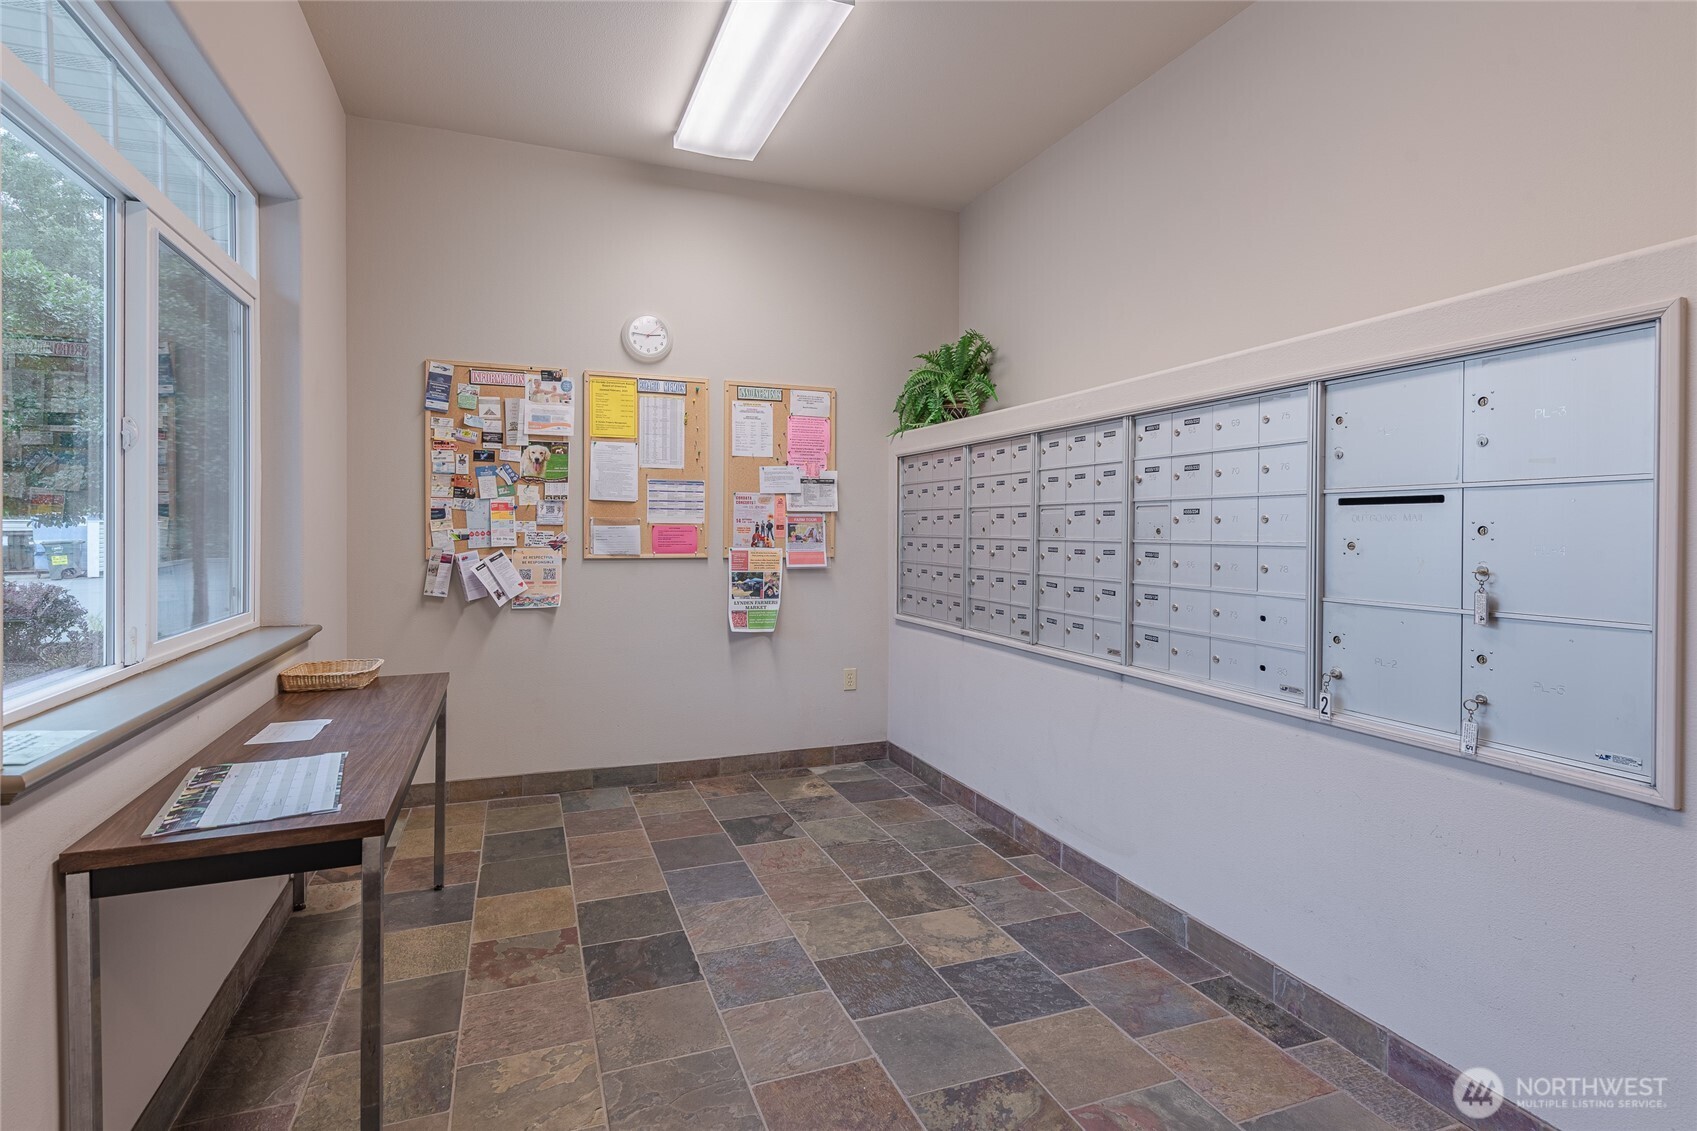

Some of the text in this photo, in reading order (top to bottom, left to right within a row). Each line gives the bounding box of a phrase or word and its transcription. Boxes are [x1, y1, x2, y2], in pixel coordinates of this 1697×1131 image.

[472, 372, 525, 385] INFORMATION
[1281, 412, 1291, 420] 75
[1534, 406, 1567, 420] PL-3
[1231, 419, 1240, 427] 69
[1280, 462, 1290, 471] 76
[1231, 467, 1240, 475] 70
[1280, 514, 1289, 522] 77
[1351, 513, 1424, 523] OUTGOING MAIL
[1278, 616, 1287, 624] 79
[1374, 657, 1398, 669] PL-2
[1277, 668, 1288, 676] 80
[1320, 696, 1328, 715] 2
